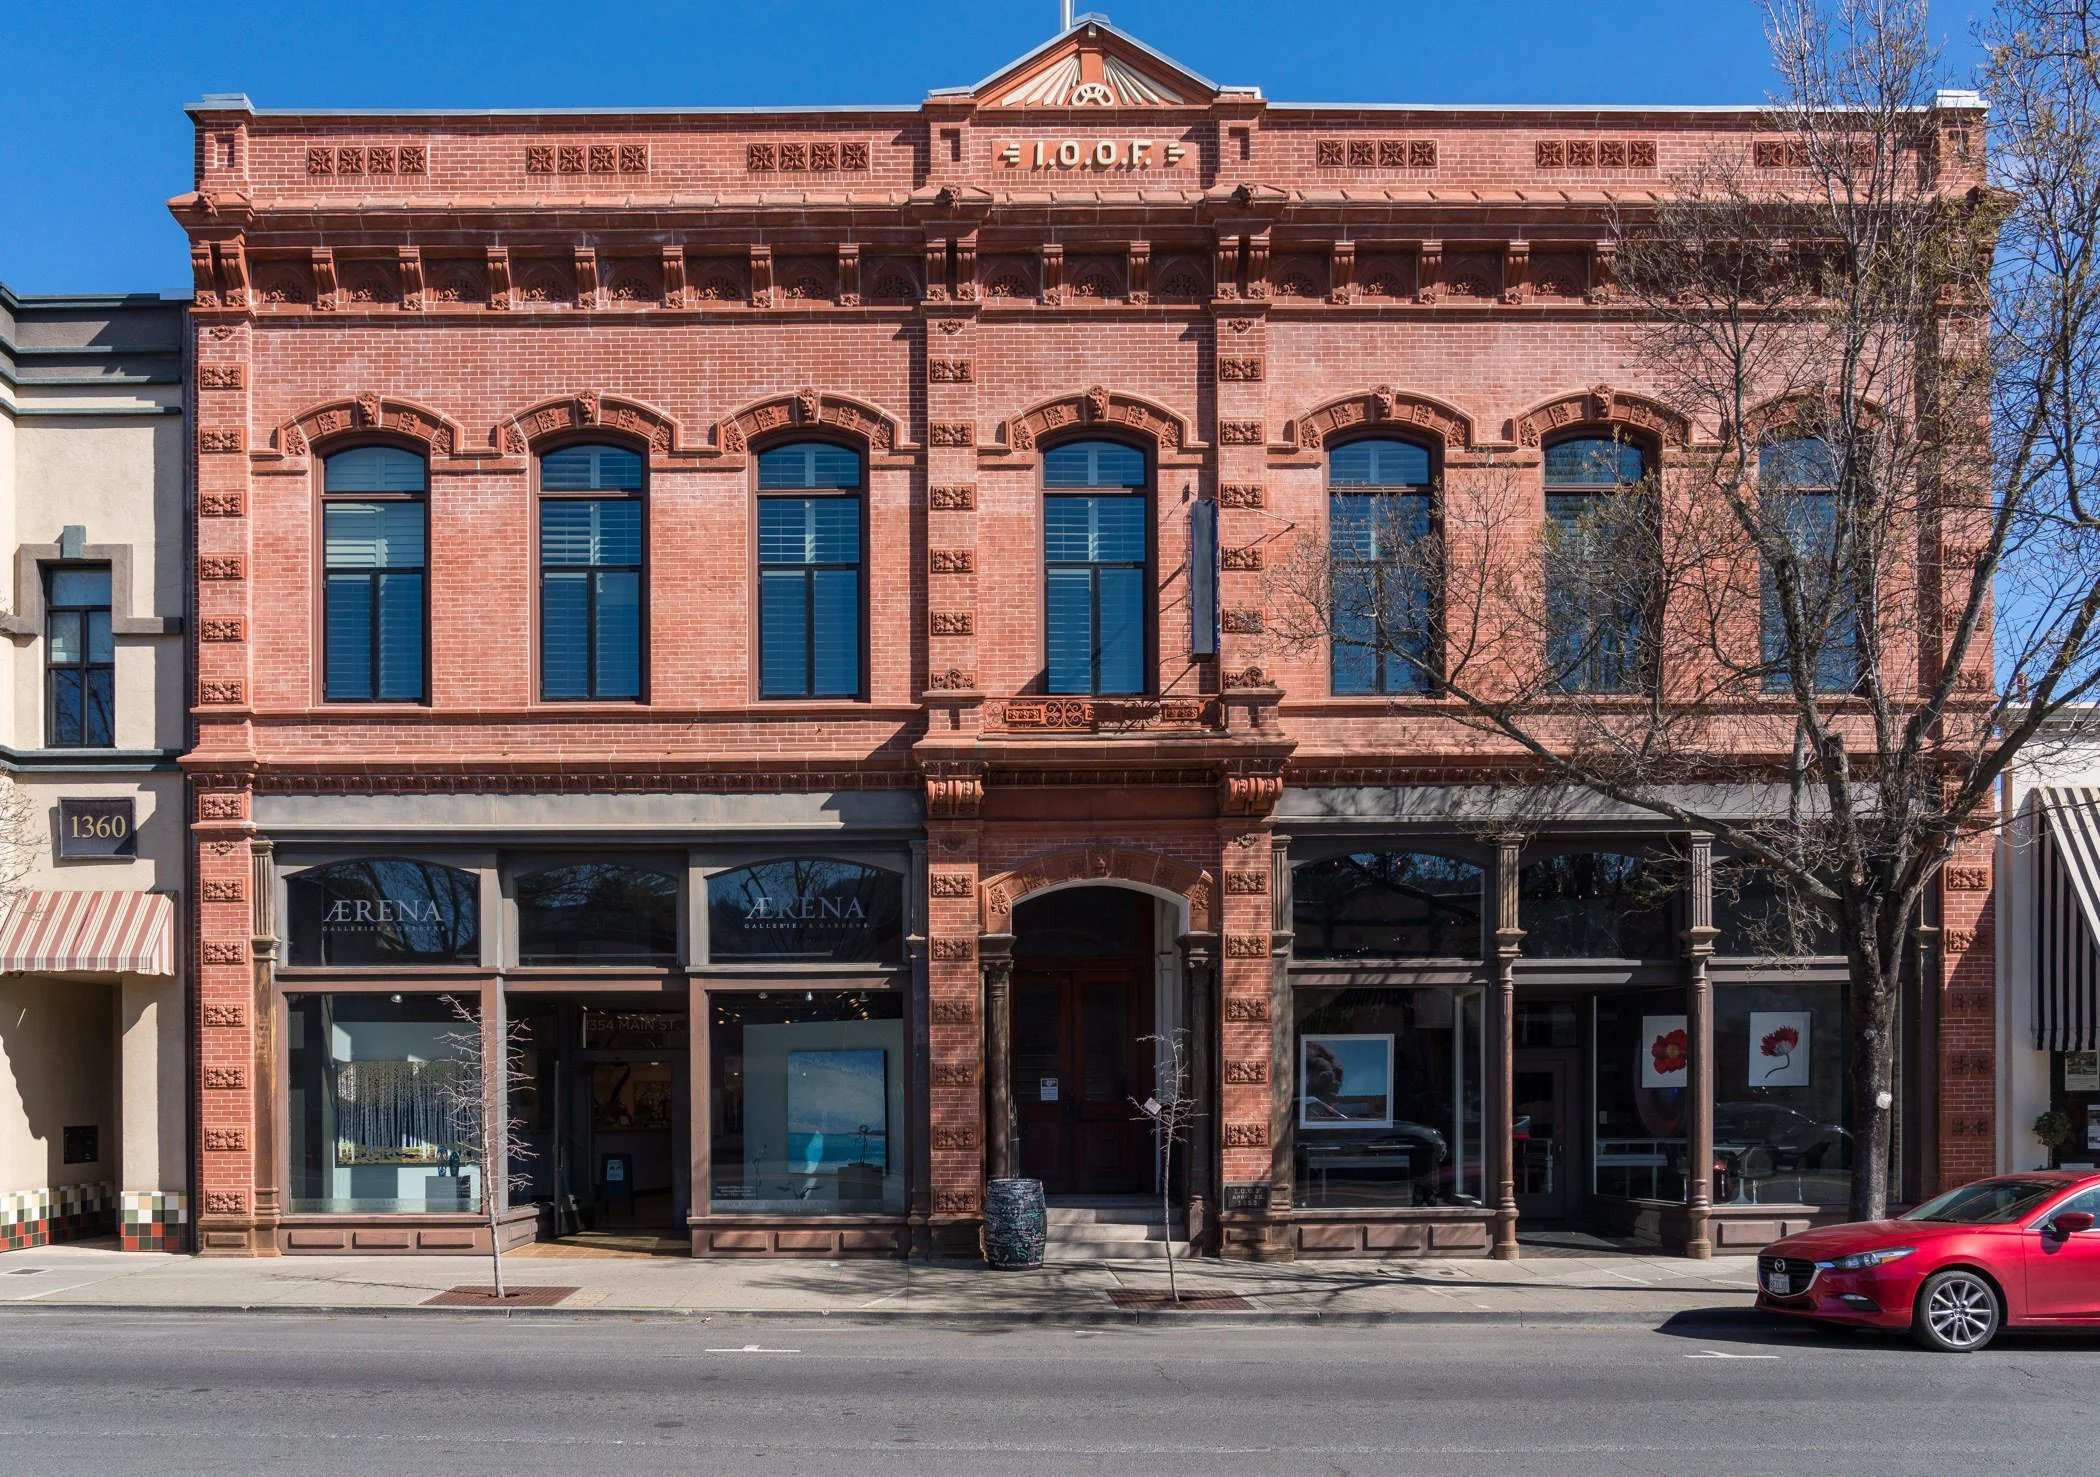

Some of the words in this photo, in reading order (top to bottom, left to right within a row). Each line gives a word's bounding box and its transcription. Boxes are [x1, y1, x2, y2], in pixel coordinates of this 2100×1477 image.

[71, 815, 126, 838] 1360
[322, 899, 445, 922] ÆRENA
[744, 897, 867, 919] ÆRENA
[618, 1019, 654, 1031] MAIN
[658, 1019, 679, 1031] ST.
